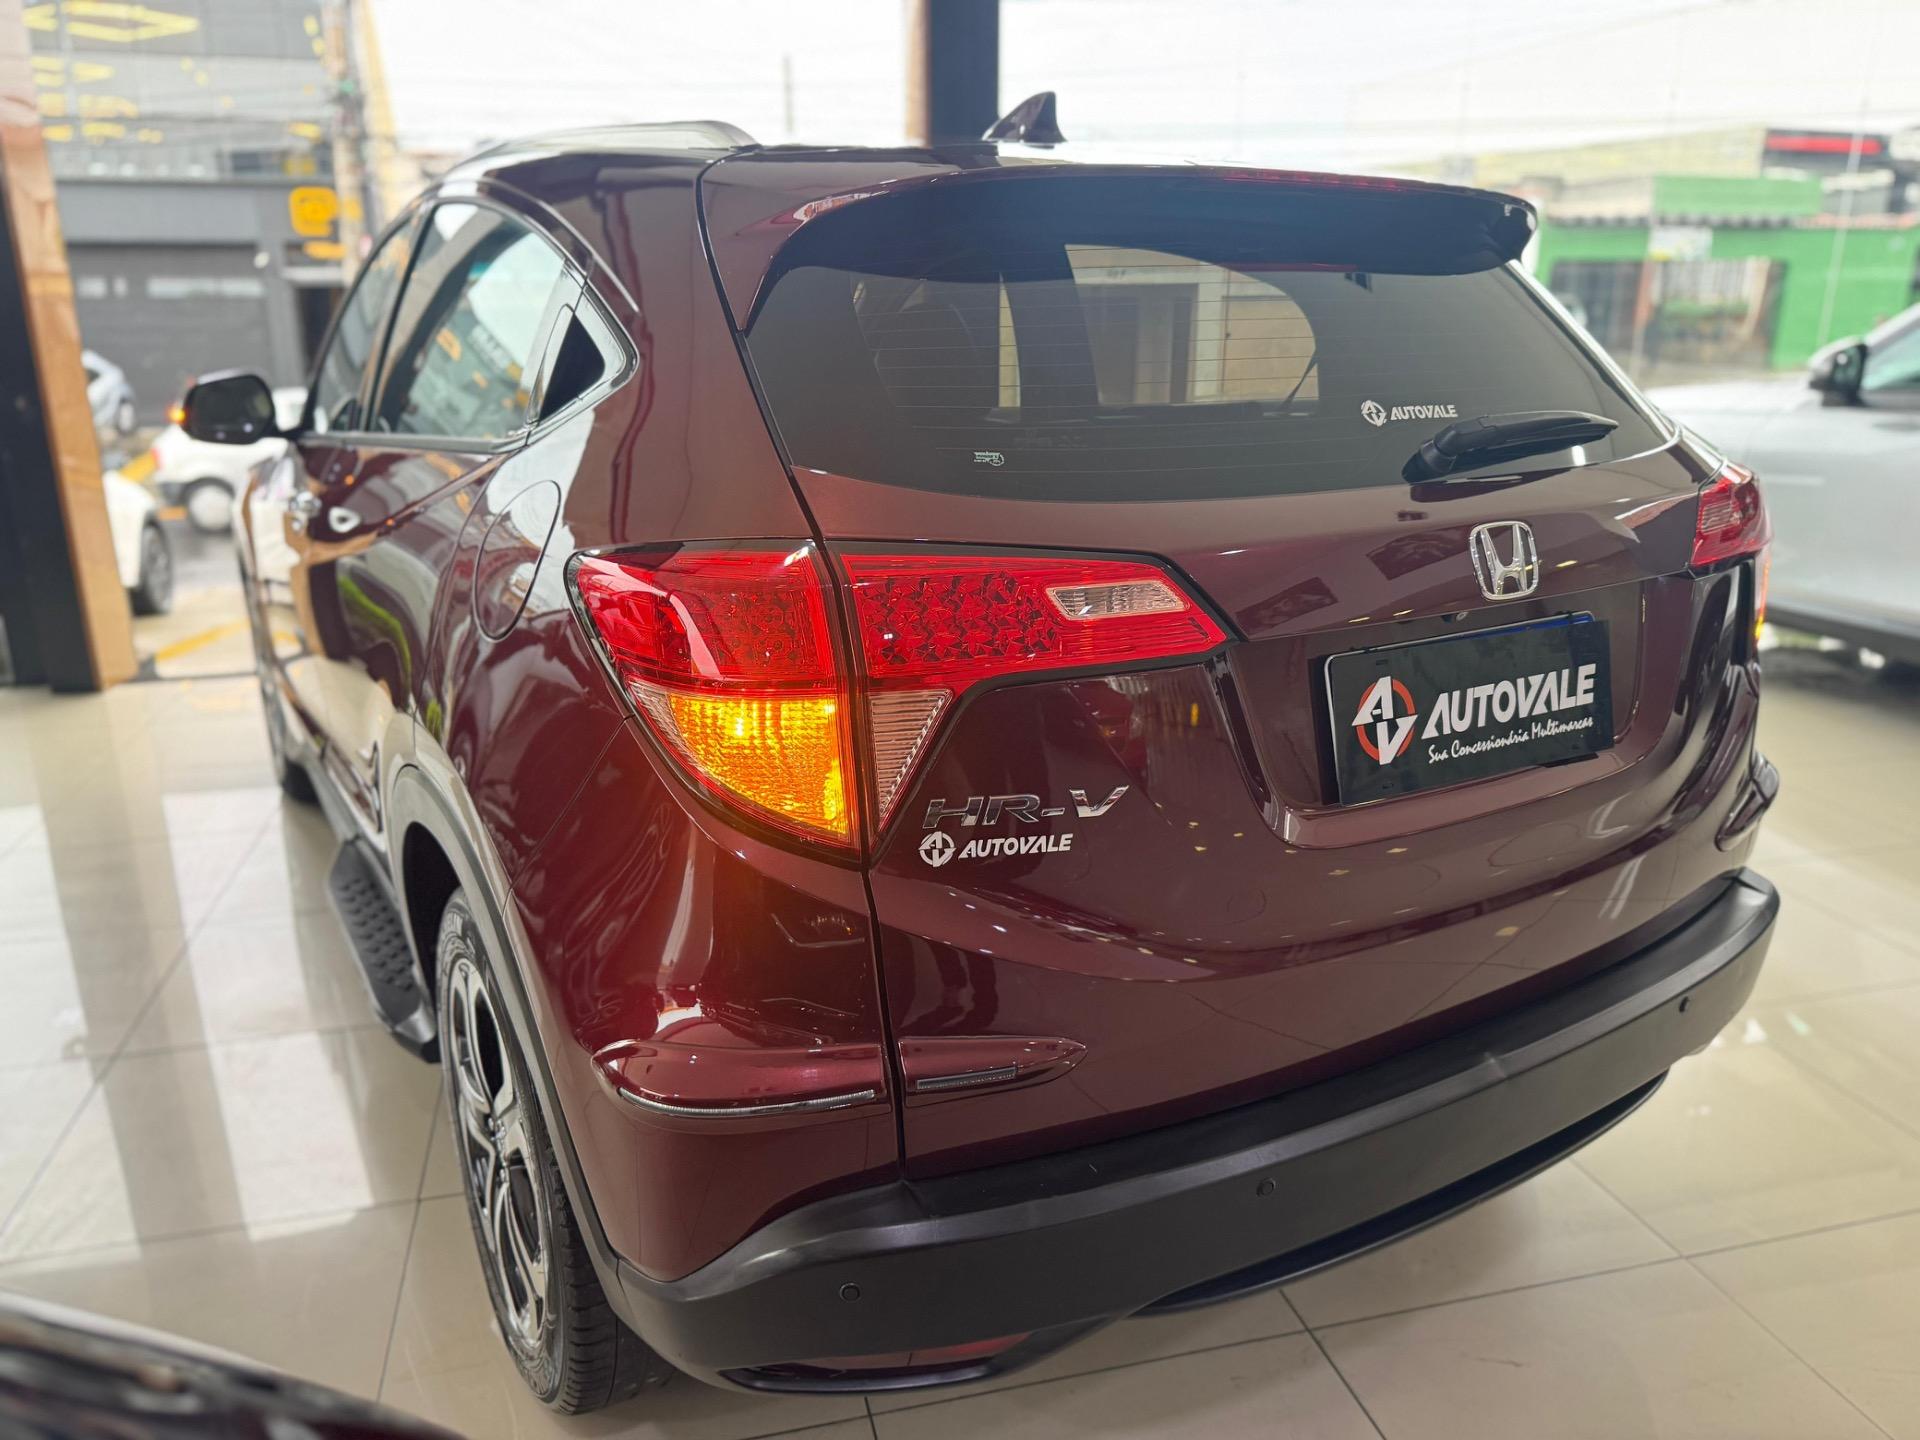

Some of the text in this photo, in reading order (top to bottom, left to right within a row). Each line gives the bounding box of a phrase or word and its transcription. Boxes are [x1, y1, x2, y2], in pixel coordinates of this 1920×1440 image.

[1390, 405, 1458, 420] AUTOVALE
[1421, 663, 1597, 740] AUTOVALE
[1428, 744, 1449, 765] Sua
[1531, 716, 1594, 740] Multimarcas
[922, 784, 1130, 829] HR-V
[958, 833, 1074, 861] AUTOVALE
